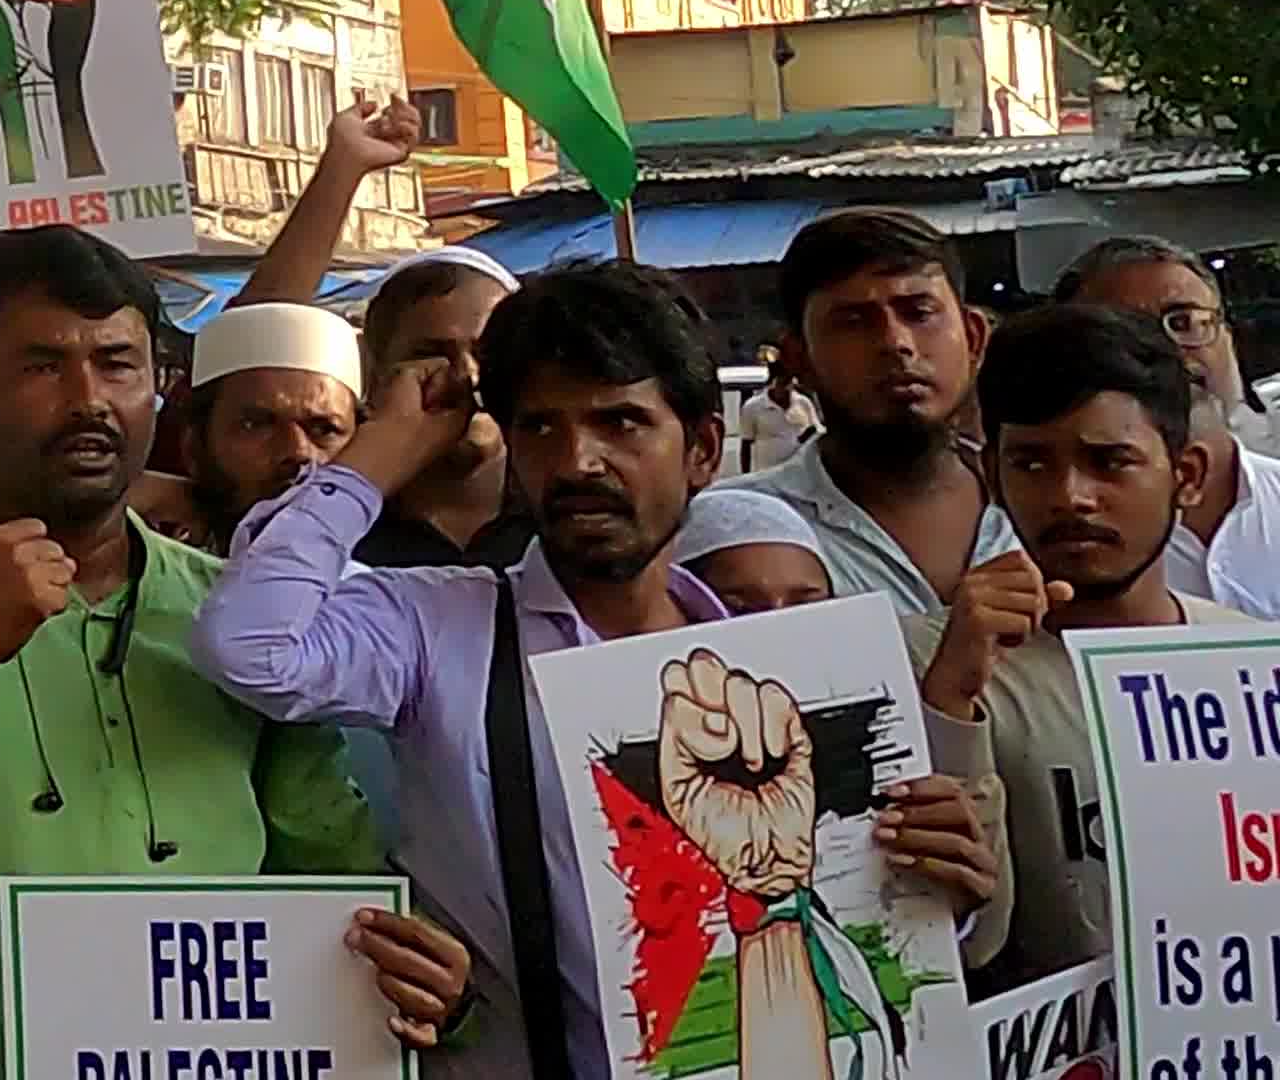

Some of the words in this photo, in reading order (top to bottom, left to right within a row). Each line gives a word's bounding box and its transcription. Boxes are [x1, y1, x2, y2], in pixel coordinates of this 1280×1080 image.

[1118, 672, 1230, 763] The
[149, 921, 272, 1020] FREE
[1155, 918, 1203, 1006] is
[1221, 936, 1253, 1004] a
